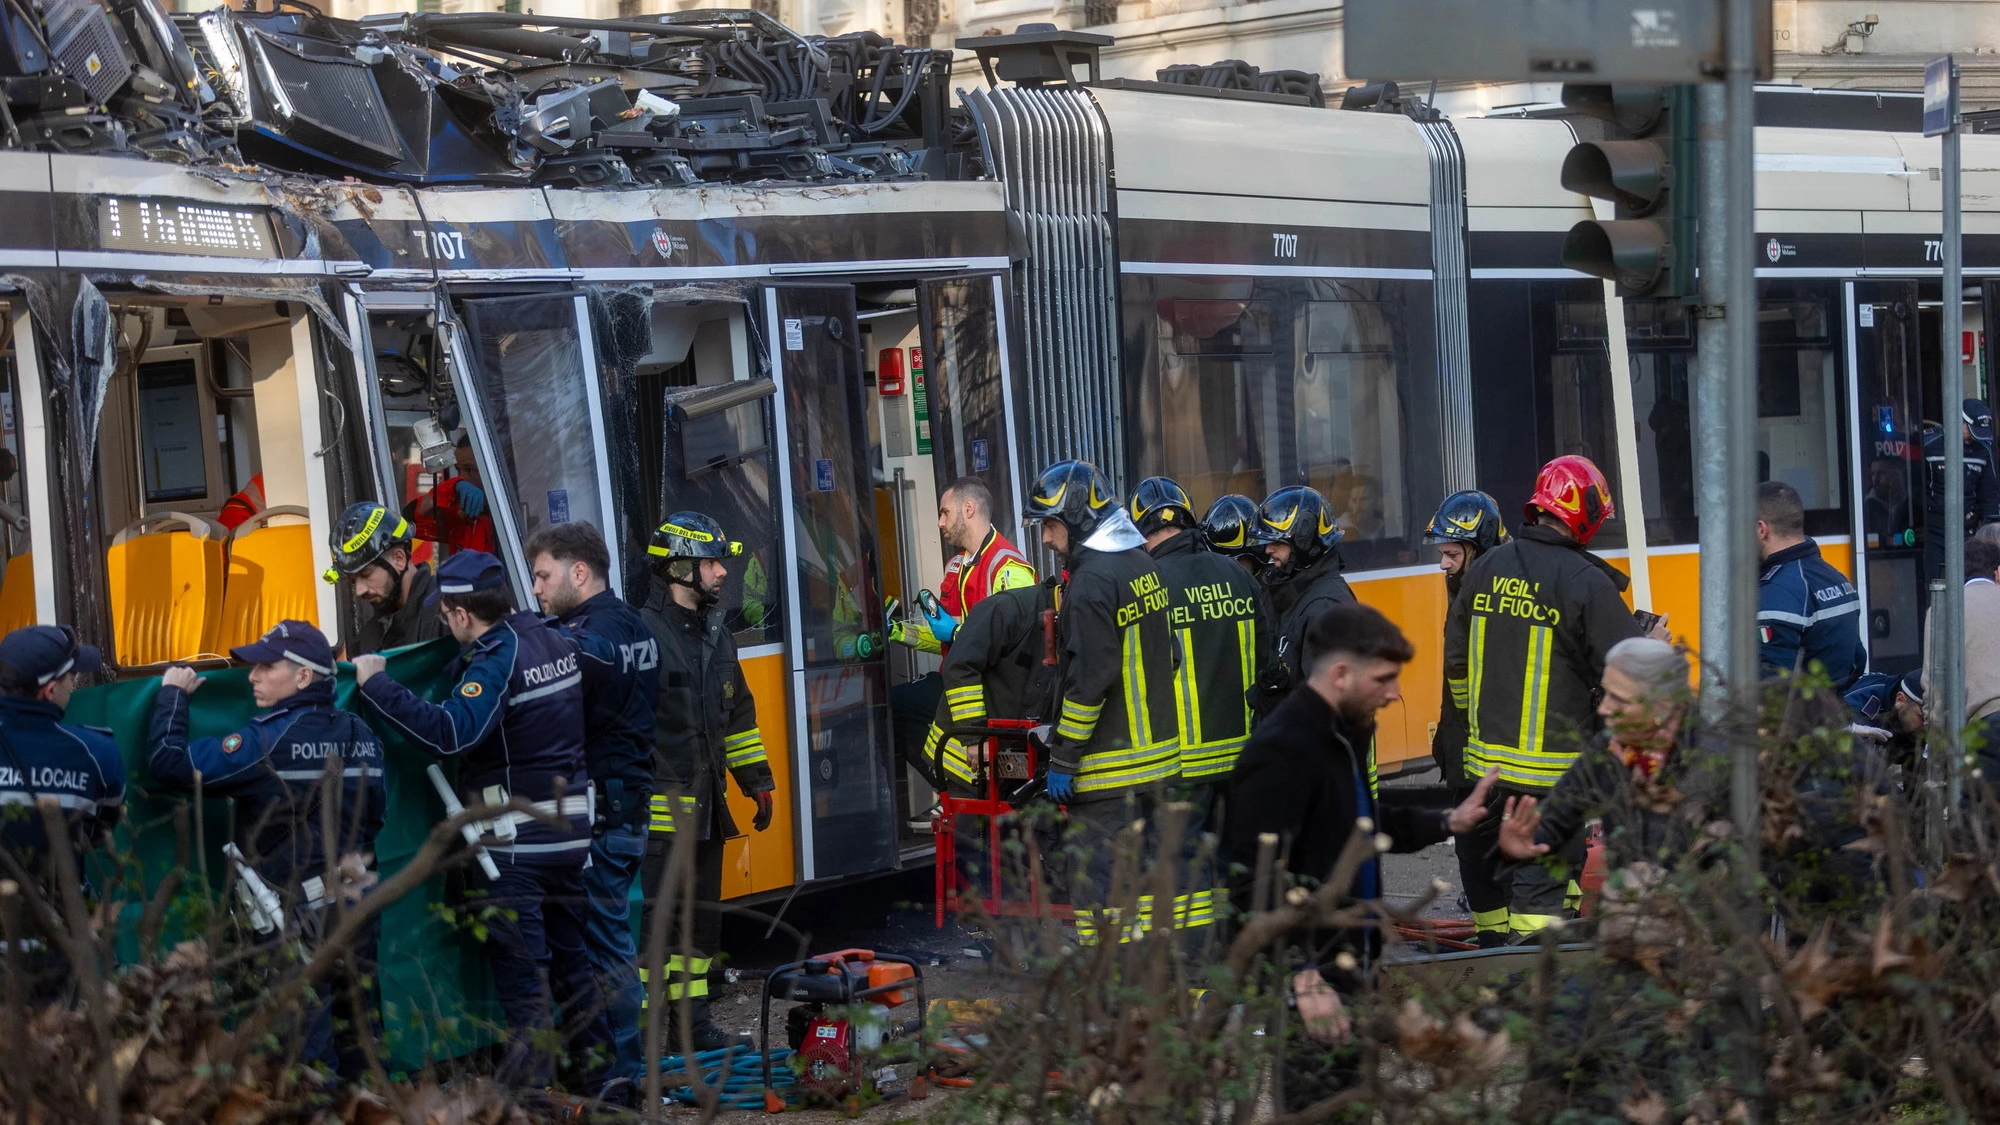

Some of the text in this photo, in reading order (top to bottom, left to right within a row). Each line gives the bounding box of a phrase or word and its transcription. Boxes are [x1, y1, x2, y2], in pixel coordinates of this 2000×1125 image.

[1272, 233, 1298, 258] 7707
[1924, 241, 1944, 262] 77
[914, 354, 923, 362] SO
[1129, 571, 1161, 598] VIGILI
[1184, 581, 1233, 604] VIGILI
[1117, 601, 1144, 627] DEL
[1171, 606, 1196, 624] EL
[31, 766, 90, 791] LOCALE
